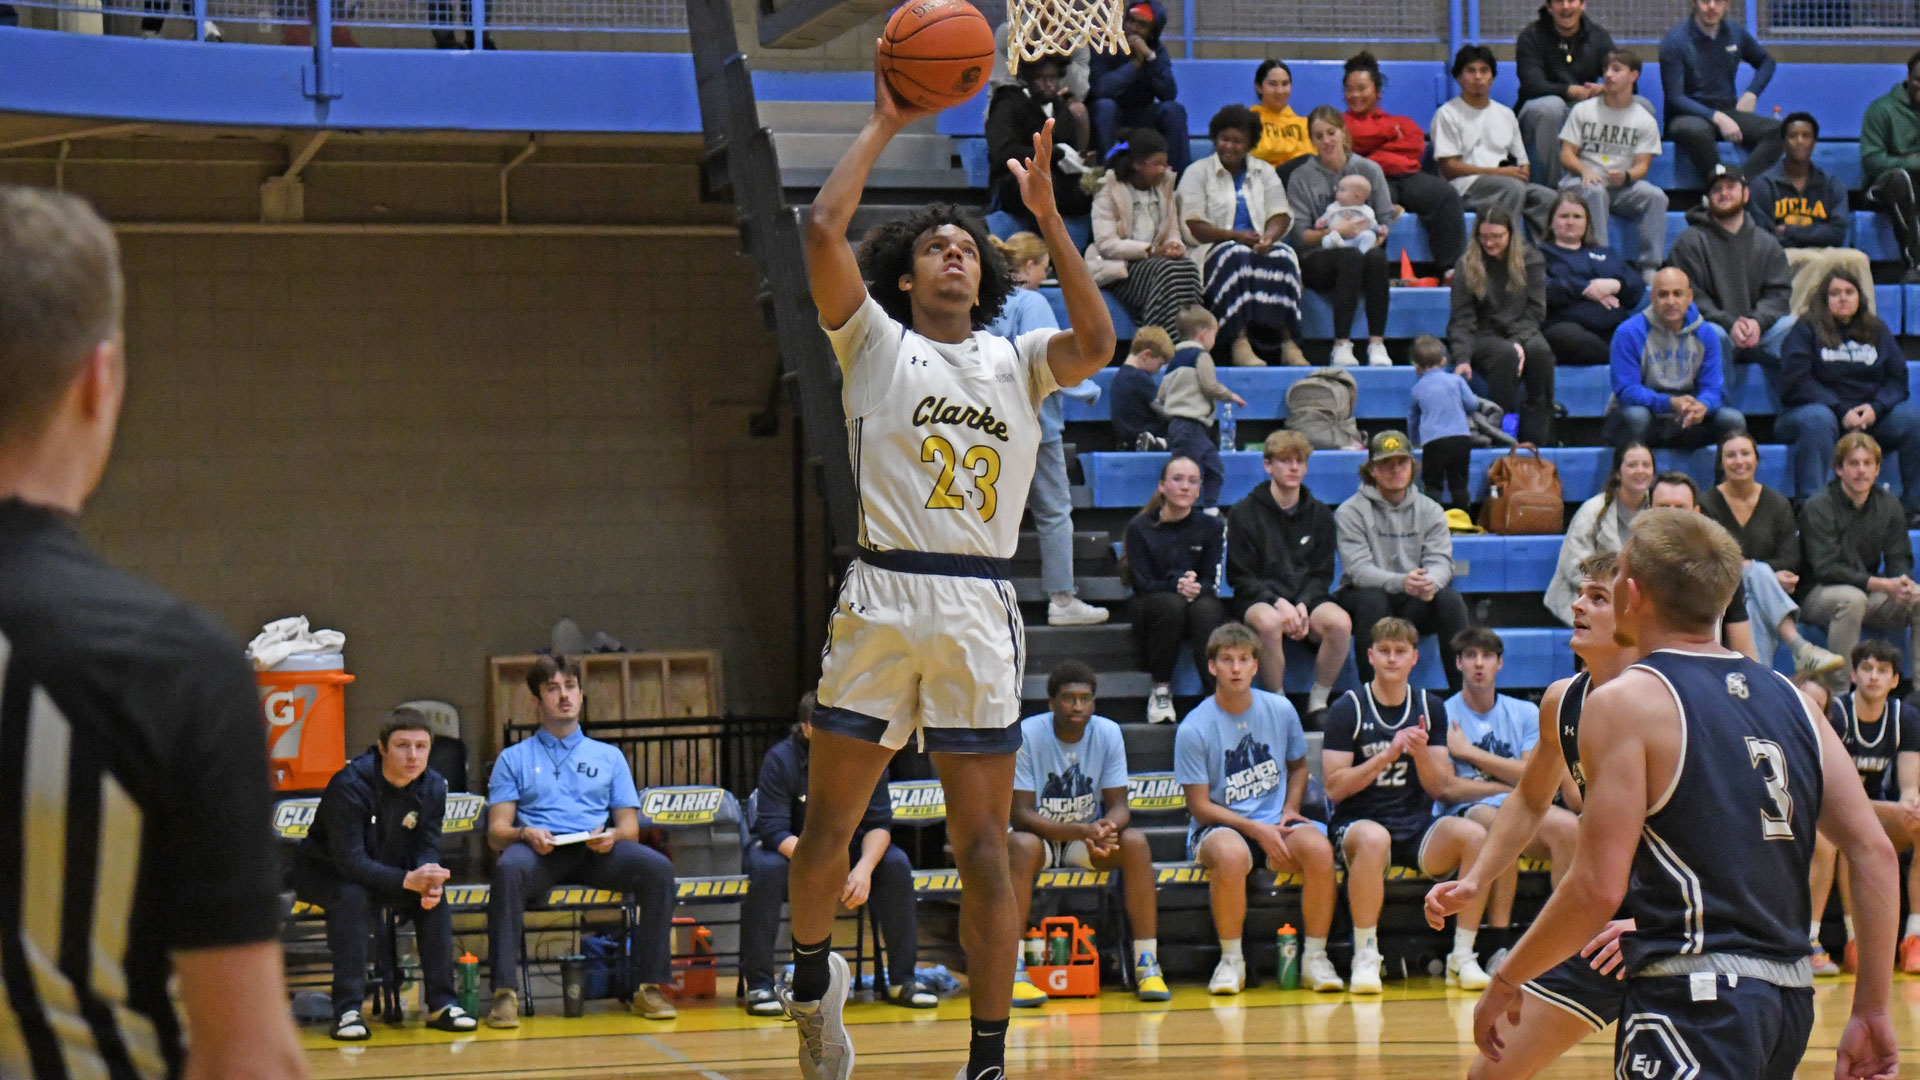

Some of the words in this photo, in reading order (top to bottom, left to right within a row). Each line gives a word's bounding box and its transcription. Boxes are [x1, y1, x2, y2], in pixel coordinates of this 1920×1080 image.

[1581, 121, 1639, 147] CLARKE
[1775, 197, 1827, 218] UCLA
[912, 395, 1009, 442] Clarke
[920, 435, 1001, 523] 23
[265, 691, 295, 726] G
[577, 762, 598, 778] EU
[1226, 759, 1278, 788] HIGHER
[1376, 761, 1408, 786] 22
[889, 787, 945, 809] CLARK
[1743, 735, 1795, 841] 3
[646, 791, 720, 814] CLARKE
[1042, 793, 1093, 813] HIGHER
[277, 806, 316, 827] CLA
[676, 880, 751, 897] PRIDE
[1036, 871, 1110, 888] PRIDE
[548, 889, 622, 905] PRIDE
[1048, 969, 1068, 990] G
[1631, 1054, 1661, 1079] EU
